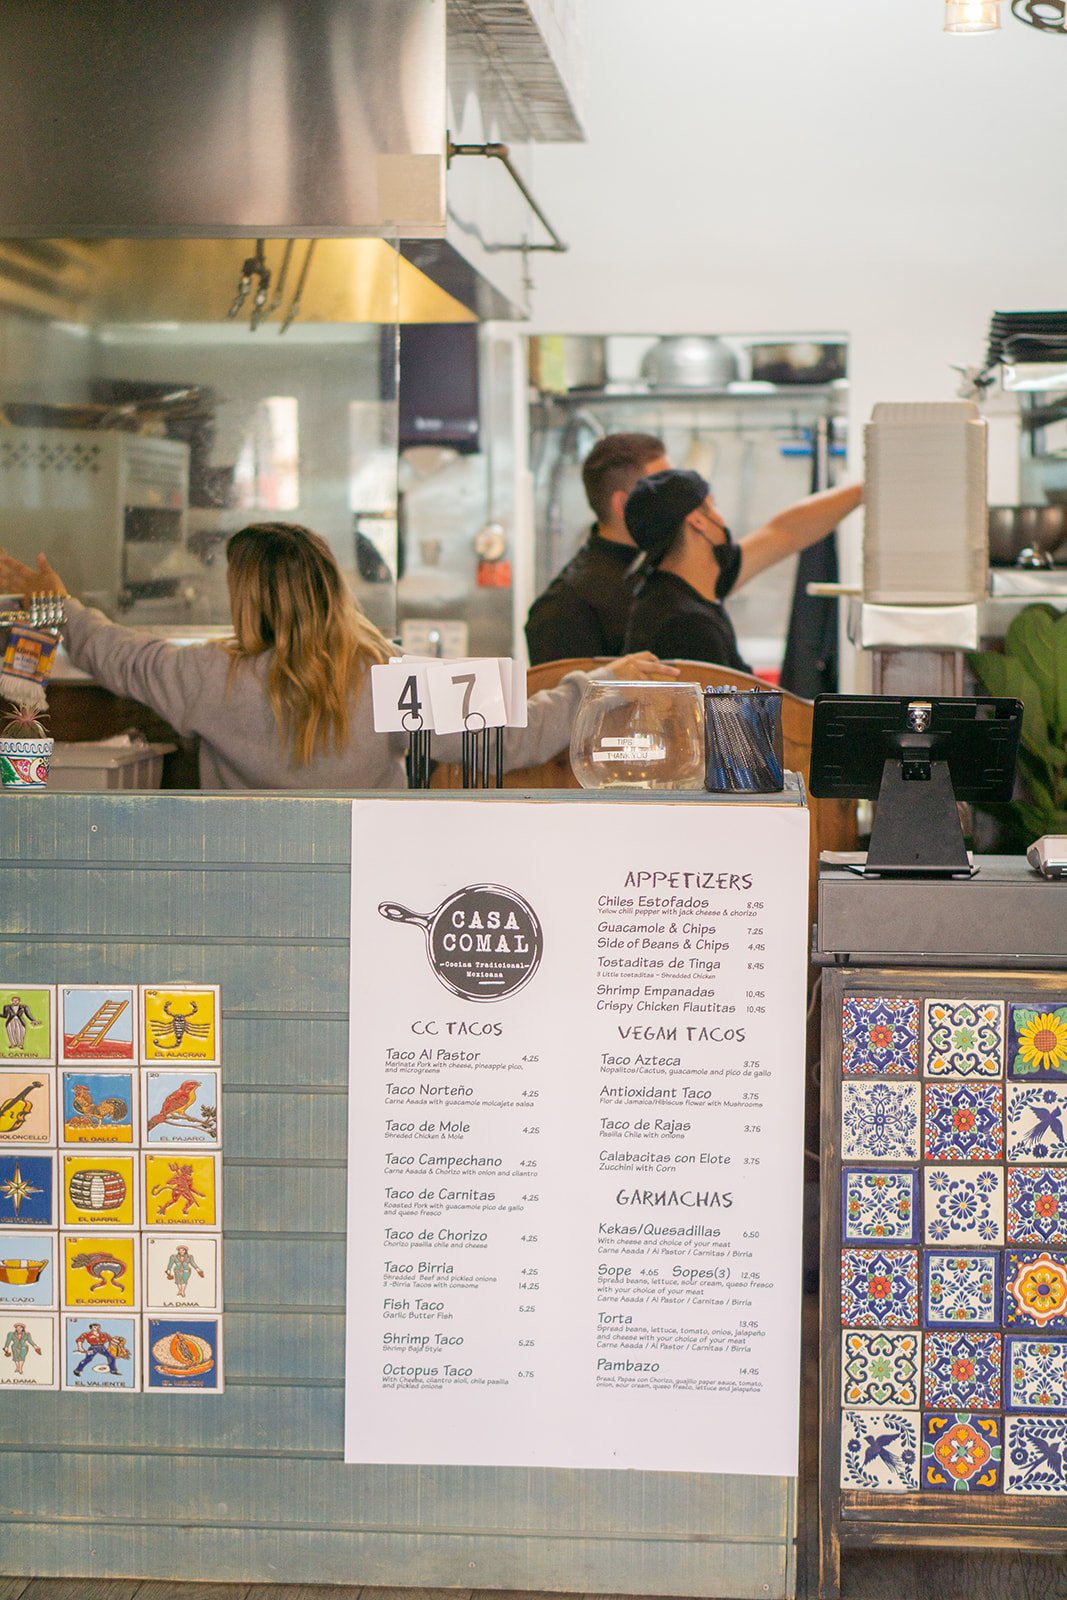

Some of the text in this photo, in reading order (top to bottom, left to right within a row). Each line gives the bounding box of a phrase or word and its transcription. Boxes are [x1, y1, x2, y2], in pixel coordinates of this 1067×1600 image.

[397, 675, 422, 719] 4
[451, 673, 476, 719] 7
[598, 895, 764, 910] Chiles Estofados 8.95
[452, 910, 520, 929] CASA
[597, 921, 763, 936] Guacamole & Chips 7.25
[443, 934, 529, 953] COMAL
[597, 937, 765, 953] Side of Beans & Chips 4.95
[597, 956, 764, 971] Tostaditas de Tinga 8.95
[597, 984, 765, 999] Shrimp Empanadas 10.95
[596, 1000, 765, 1013] Crispy Chicken Flautitas 10.95
[411, 1020, 503, 1036] CC TACOS
[617, 1025, 746, 1042] VEGAN TACOS
[386, 1047, 416, 1061] Taco
[419, 1048, 432, 1061] Al
[436, 1048, 480, 1062] Pastor
[601, 1052, 760, 1069] Taco Azteca 3.75
[385, 1082, 415, 1096] Taco
[419, 1083, 473, 1097] Norteño
[600, 1085, 759, 1100] Antioxidant Taco 3.75
[385, 1119, 540, 1134] Taco de Mole 4.25
[600, 1117, 630, 1132] Taco
[634, 1118, 650, 1132] de
[654, 1118, 691, 1133] Rajas
[385, 1152, 414, 1165] Taco
[418, 1153, 502, 1168] Campechano
[599, 1150, 760, 1166] Calabacitas con Elote 3.75
[385, 1186, 414, 1199] Taco
[418, 1187, 434, 1200] de
[438, 1187, 495, 1201] Carnitas
[616, 1188, 733, 1208] GARNACHAS
[384, 1227, 414, 1241] Taco
[418, 1228, 434, 1241] de
[438, 1228, 487, 1242] Chorizo
[599, 1222, 759, 1238] Kekas/Quesadillas 6.50
[384, 1260, 538, 1276] Taco Birria 4.25
[597, 1263, 760, 1282] Sope 4.65 Sopes(3) 12.95
[518, 1282, 539, 1290] 14.25
[383, 1297, 410, 1311] Fish
[414, 1298, 444, 1312] Taco
[597, 1311, 758, 1329] Torta 13.95
[383, 1332, 535, 1348] Shrimp Taco 5.25
[382, 1363, 438, 1378] Octopus
[443, 1364, 472, 1378] Taco
[597, 1358, 759, 1375] Pambazo 14.95
